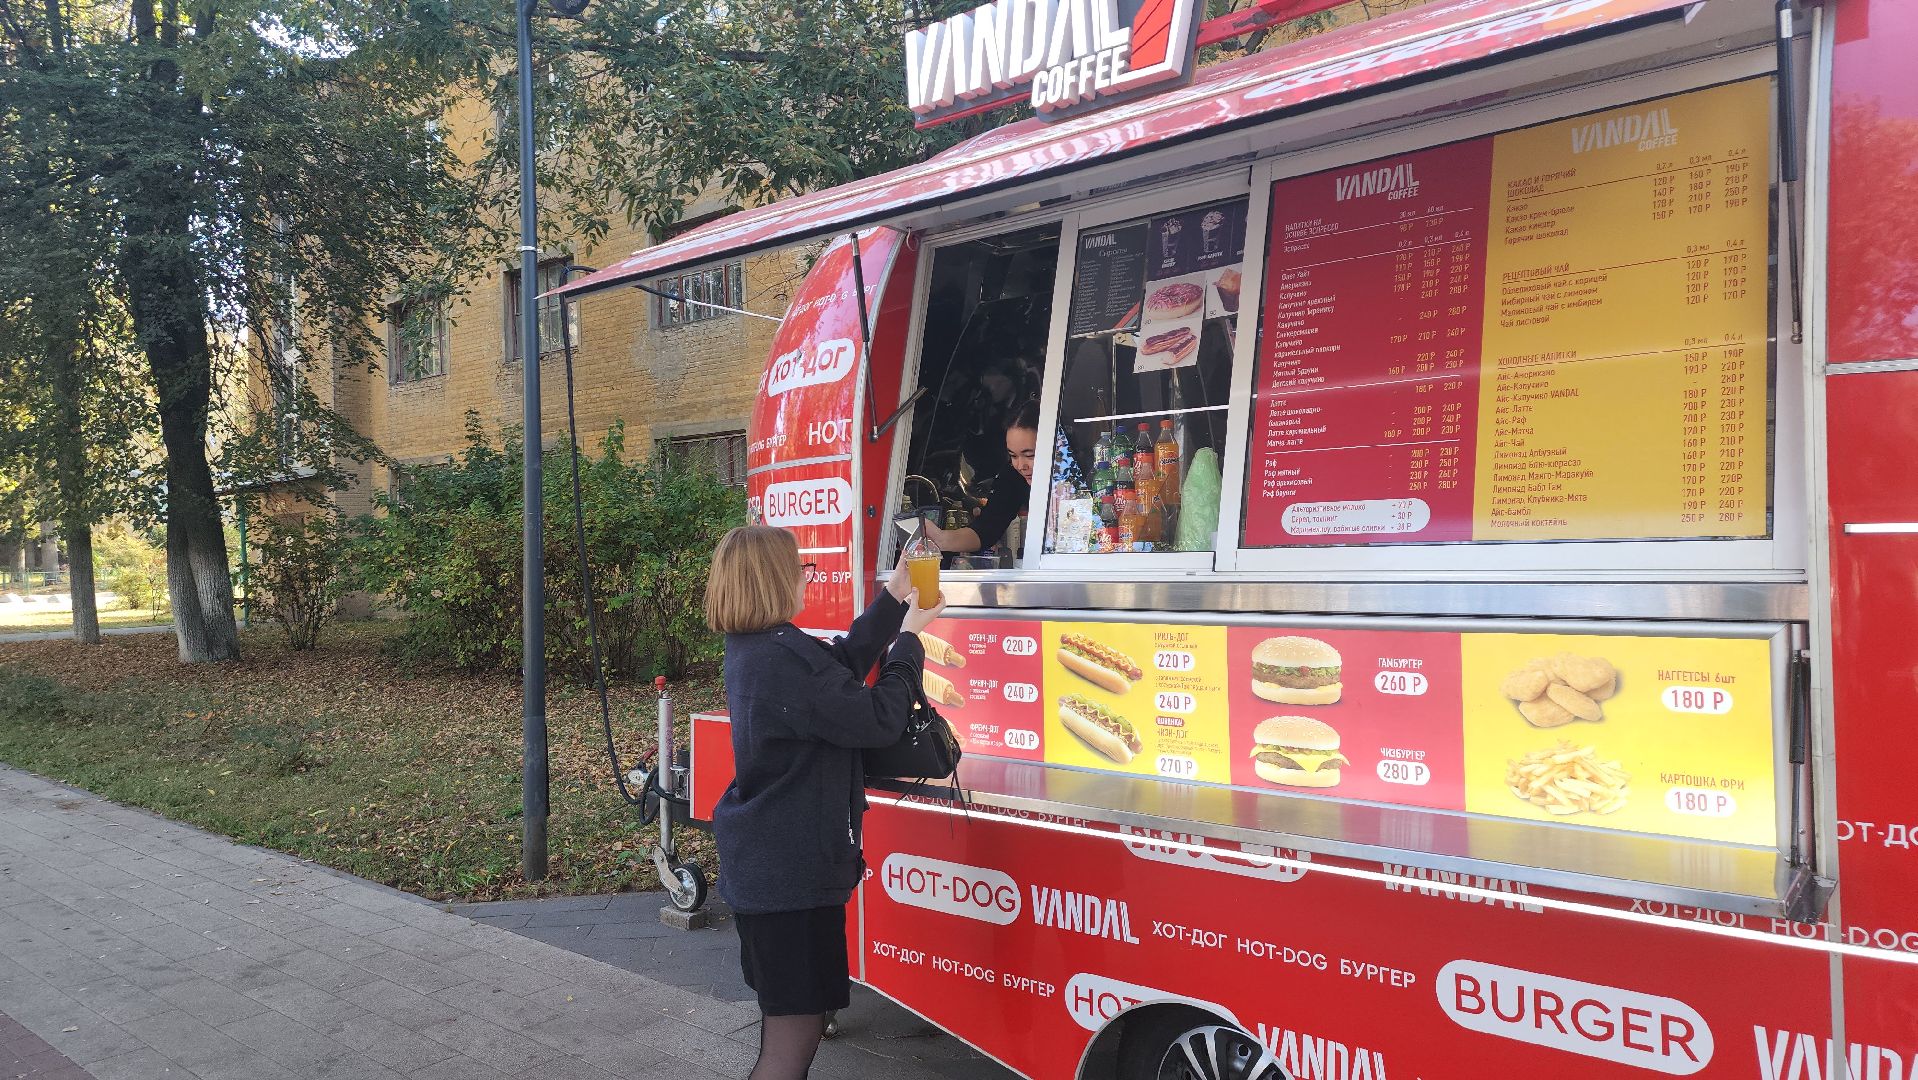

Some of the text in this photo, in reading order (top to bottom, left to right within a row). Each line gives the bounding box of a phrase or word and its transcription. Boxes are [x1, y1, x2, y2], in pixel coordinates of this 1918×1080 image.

[905, 0, 1130, 108] VANDAL
[1030, 45, 1129, 108] COFFEE
[1571, 108, 1679, 154] VANDAL
[1637, 132, 1679, 152] COFFEE
[1336, 162, 1420, 201] VANDAL
[1388, 187, 1420, 201] COFFEE
[1550, 387, 1579, 398] VANDAL
[769, 487, 841, 518] BURGER
[1006, 639, 1023, 652] 220
[1154, 632, 1189, 642] ГРИЛЬ-ДОГ
[1158, 653, 1178, 668] 220
[1378, 657, 1422, 669] ГАМБУРГЕР
[1380, 675, 1406, 691] 260
[1658, 669, 1736, 684] НАГГЕТСЫ 6шт
[1007, 685, 1024, 699] 240
[1671, 689, 1705, 709] 180
[1159, 695, 1179, 709] 240
[1008, 732, 1025, 746] 240
[1380, 747, 1426, 760] ЧИЗБУРГЕР
[1161, 758, 1181, 773] 270
[1383, 762, 1408, 780] 280
[1660, 772, 1745, 790] КАРТОШКА ФРИ
[1674, 791, 1708, 811] 180
[888, 864, 1017, 913] HOT-DOG
[1030, 884, 1140, 945] VANDAL
[1152, 920, 1227, 948] ХОТ-ДОГ
[1237, 937, 1328, 970] HOT-DOG
[1340, 958, 1416, 988] БУРГЕР
[872, 940, 1055, 998] ХОТ-ДОГ HOT-DOG БУРГЕР
[1453, 972, 1702, 1064] BURGER
